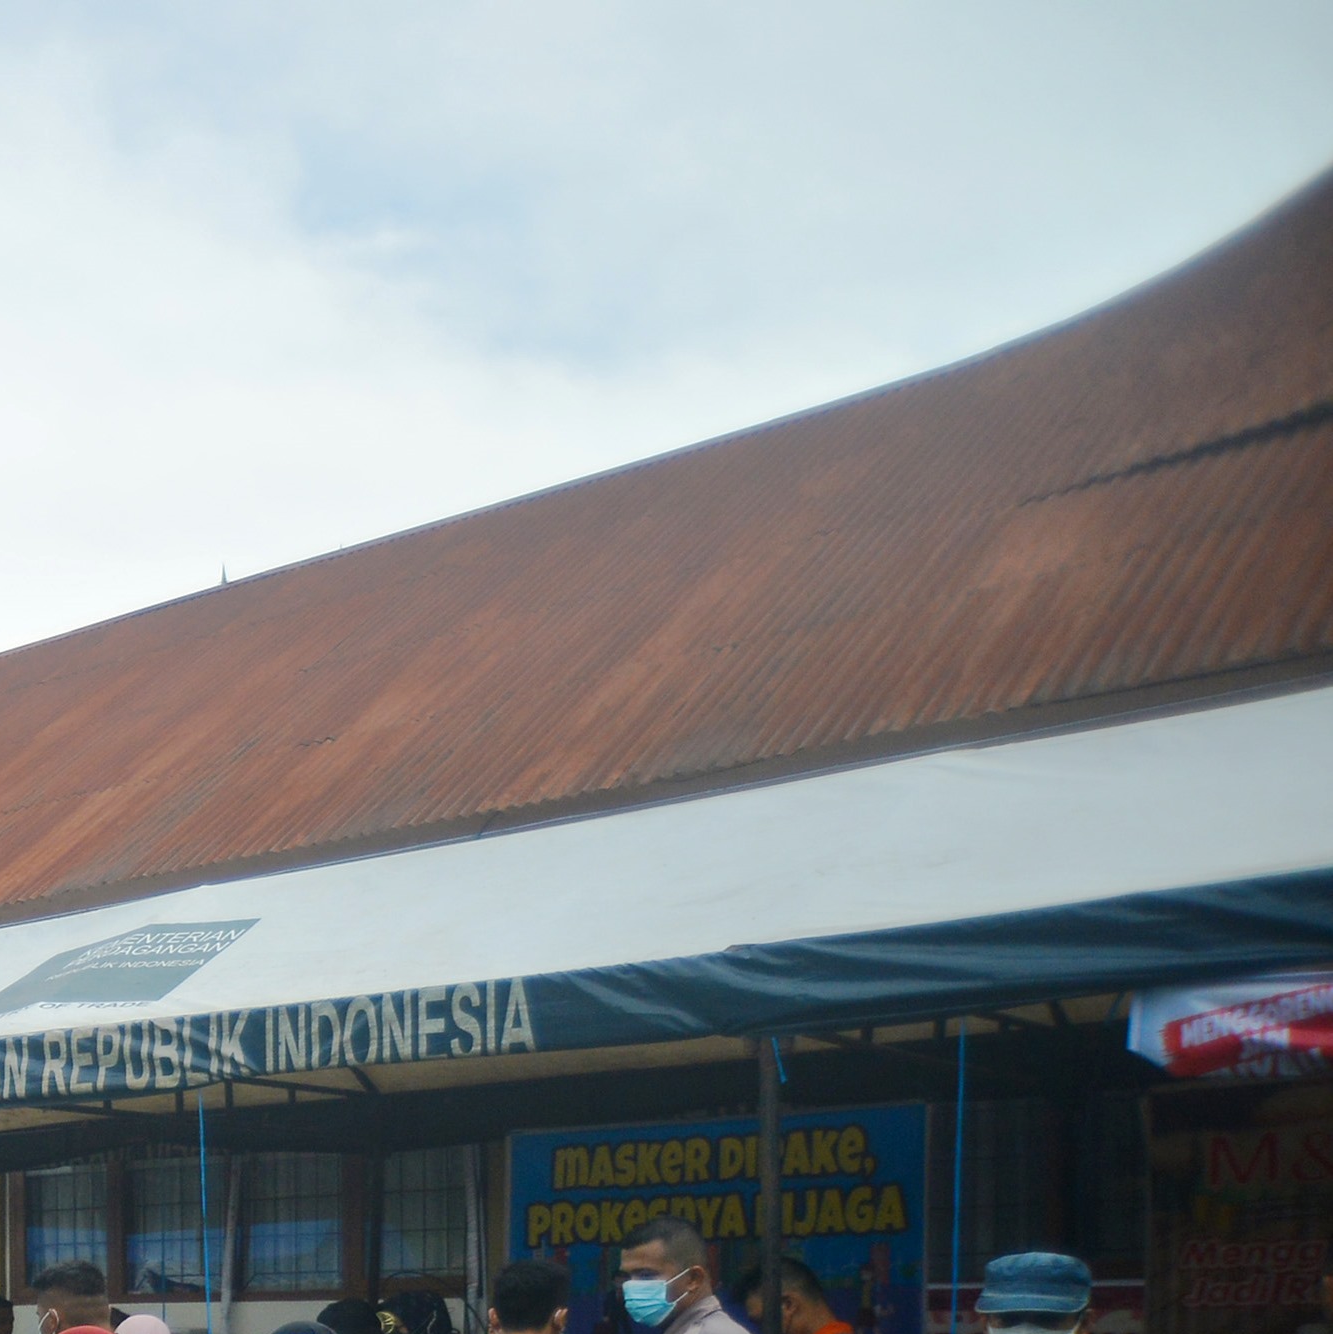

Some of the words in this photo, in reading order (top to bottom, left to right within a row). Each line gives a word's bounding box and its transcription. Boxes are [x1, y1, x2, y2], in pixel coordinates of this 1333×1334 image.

[118, 958, 205, 969] INDONESIA
[41, 1010, 249, 1097] REPUBLIK
[266, 977, 534, 1076] INDONESIA
[554, 1136, 712, 1190] MASKER
[719, 1125, 877, 1182] DIAKE,
